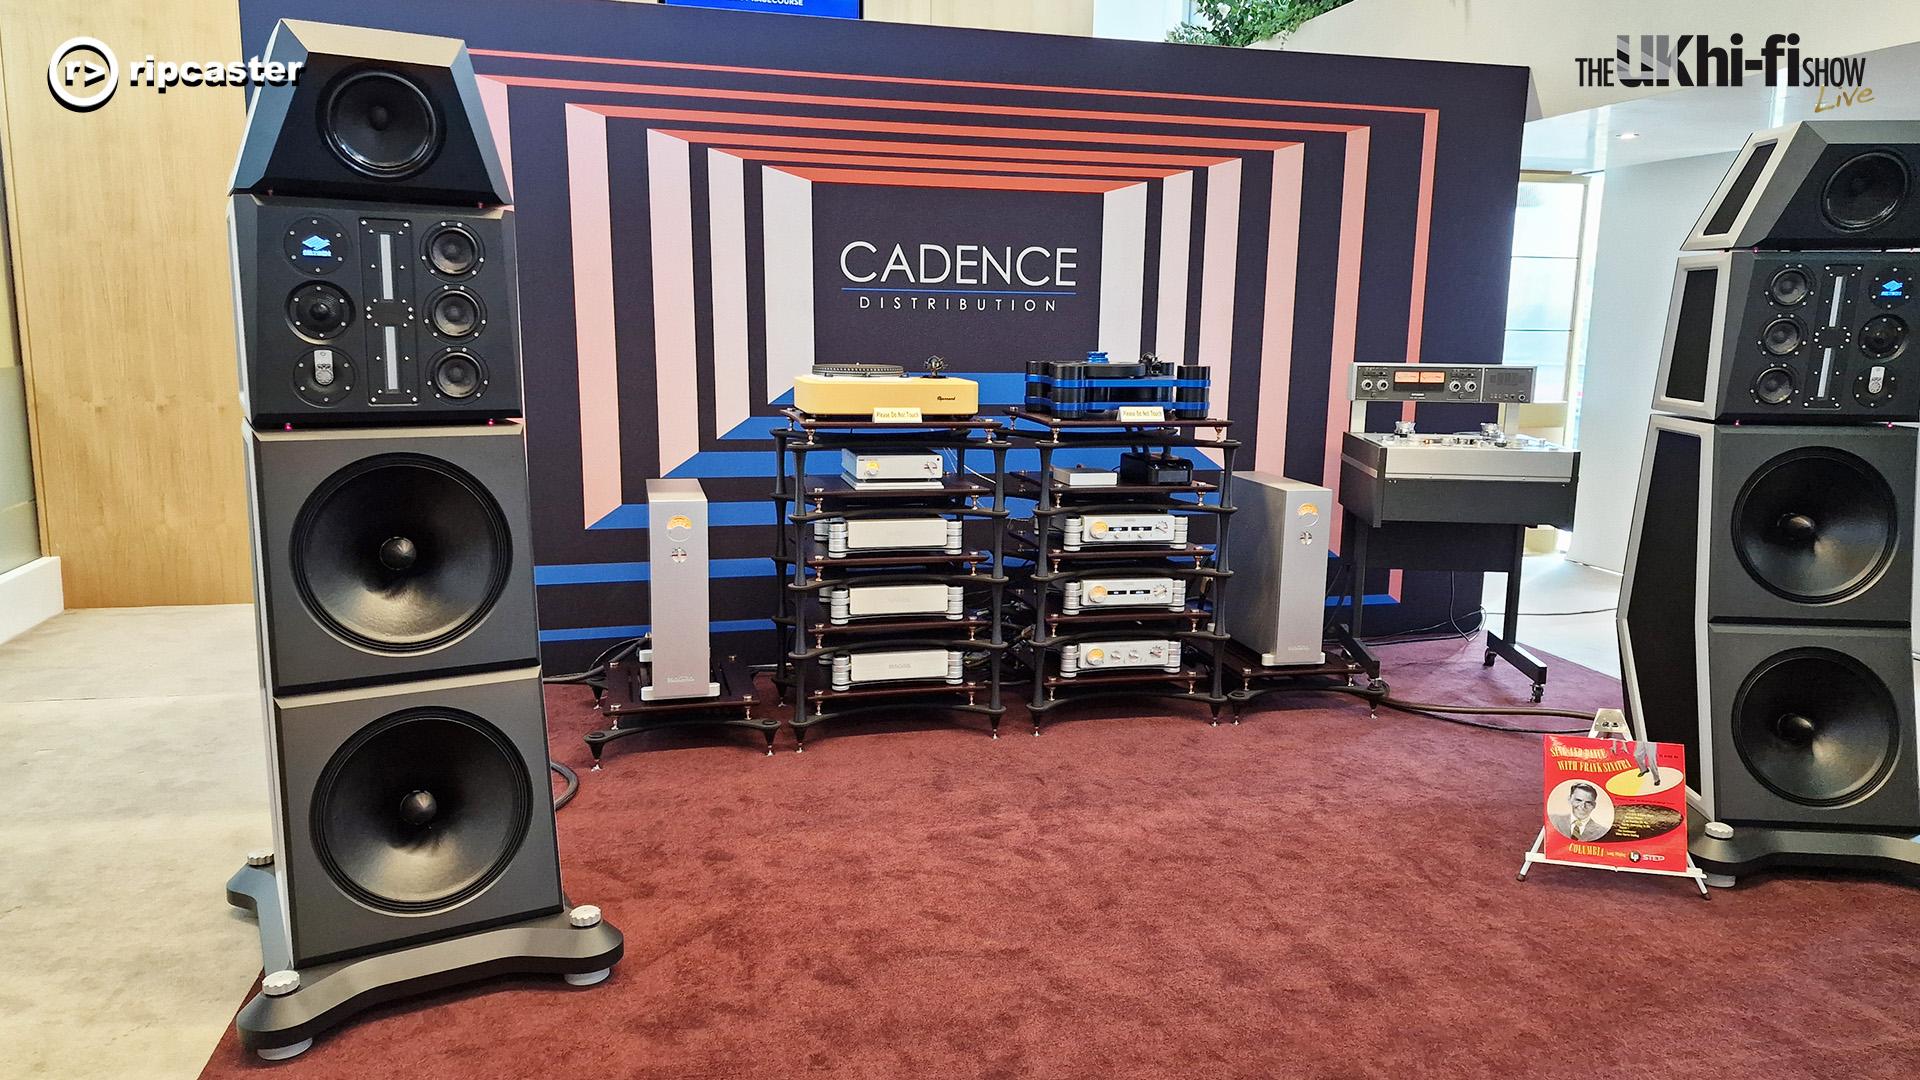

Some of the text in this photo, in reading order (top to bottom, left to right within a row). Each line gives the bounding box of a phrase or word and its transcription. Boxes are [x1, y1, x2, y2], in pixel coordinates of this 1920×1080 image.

[840, 240, 1078, 287] CADENCE
[859, 296, 1056, 312] DISTRIBUTION
[1557, 758, 1632, 773] WITH FRANK SINATRA
[1568, 842, 1605, 857] COLUMBIA
